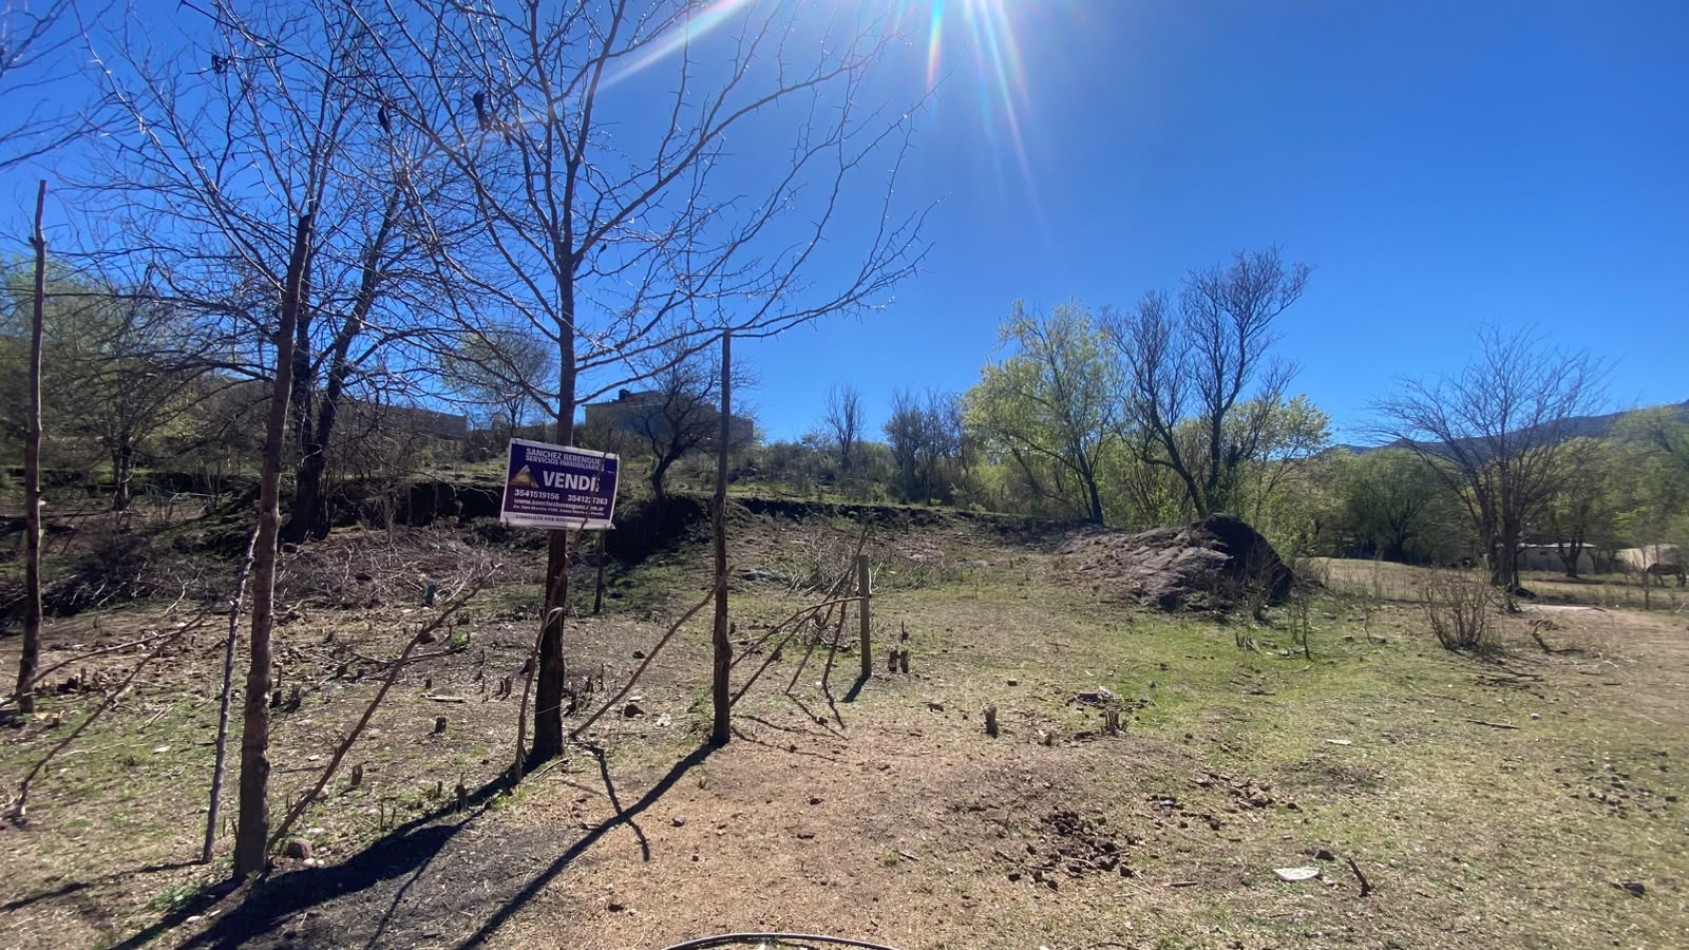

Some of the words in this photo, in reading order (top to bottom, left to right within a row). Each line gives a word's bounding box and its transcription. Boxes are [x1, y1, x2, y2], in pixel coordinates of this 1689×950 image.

[525, 455, 559, 466] SERVICIOS
[526, 448, 562, 460] SANCHEZ
[563, 453, 603, 465] BERENGUE
